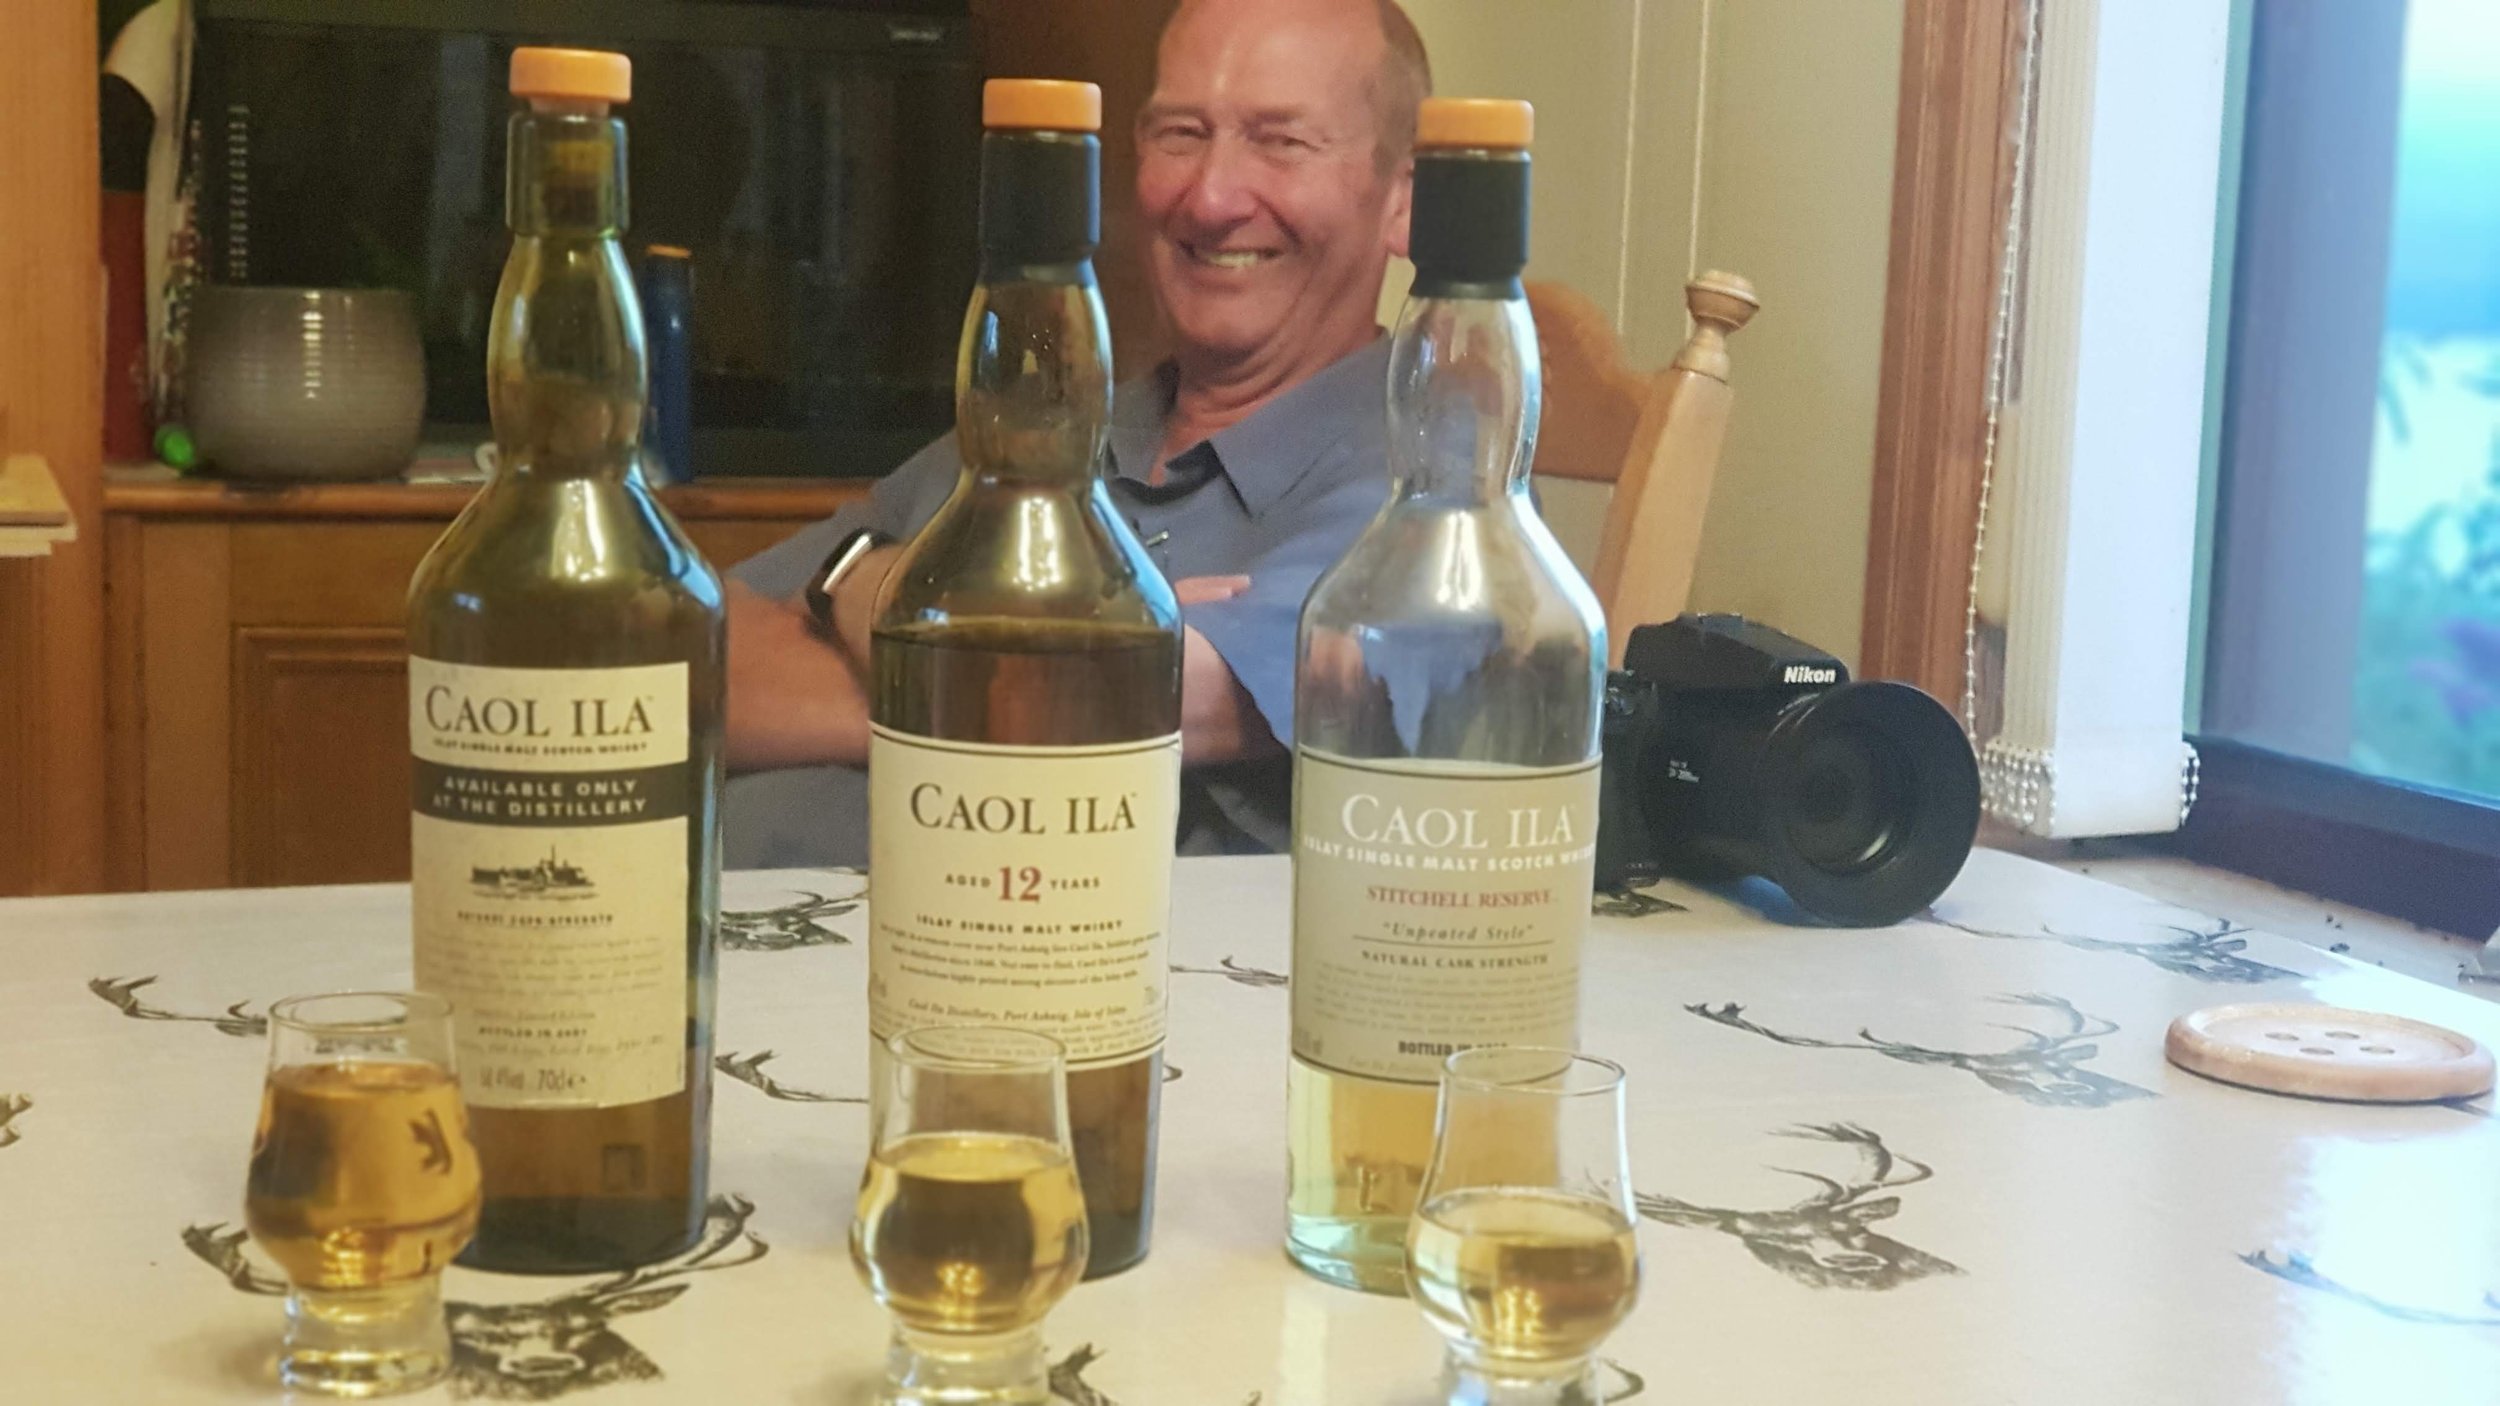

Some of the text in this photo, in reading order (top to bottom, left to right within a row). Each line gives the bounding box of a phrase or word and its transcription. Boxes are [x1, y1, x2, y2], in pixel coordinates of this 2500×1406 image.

[1784, 666, 1836, 683] Nikon
[425, 684, 653, 738] CAOL ILA
[445, 776, 638, 797] AVAILABLE ONLY
[433, 794, 647, 816] AT THE DISTILLERY
[910, 782, 1137, 834] CAOL ILA
[1341, 793, 1574, 849] CAOL ILA
[1346, 846, 1416, 868] SINGLE
[1422, 855, 1478, 871] MALT
[1487, 854, 1554, 871] SCOTCH
[945, 866, 1101, 902] AGED 12 YEARS
[1366, 885, 1469, 907] STITCHELL
[916, 914, 1122, 934] ISLAY SINGLE MALT WHISKY
[1361, 949, 1549, 969] NATURAL CASK STRENGTH
[1398, 1040, 1452, 1056] BOTTLED
